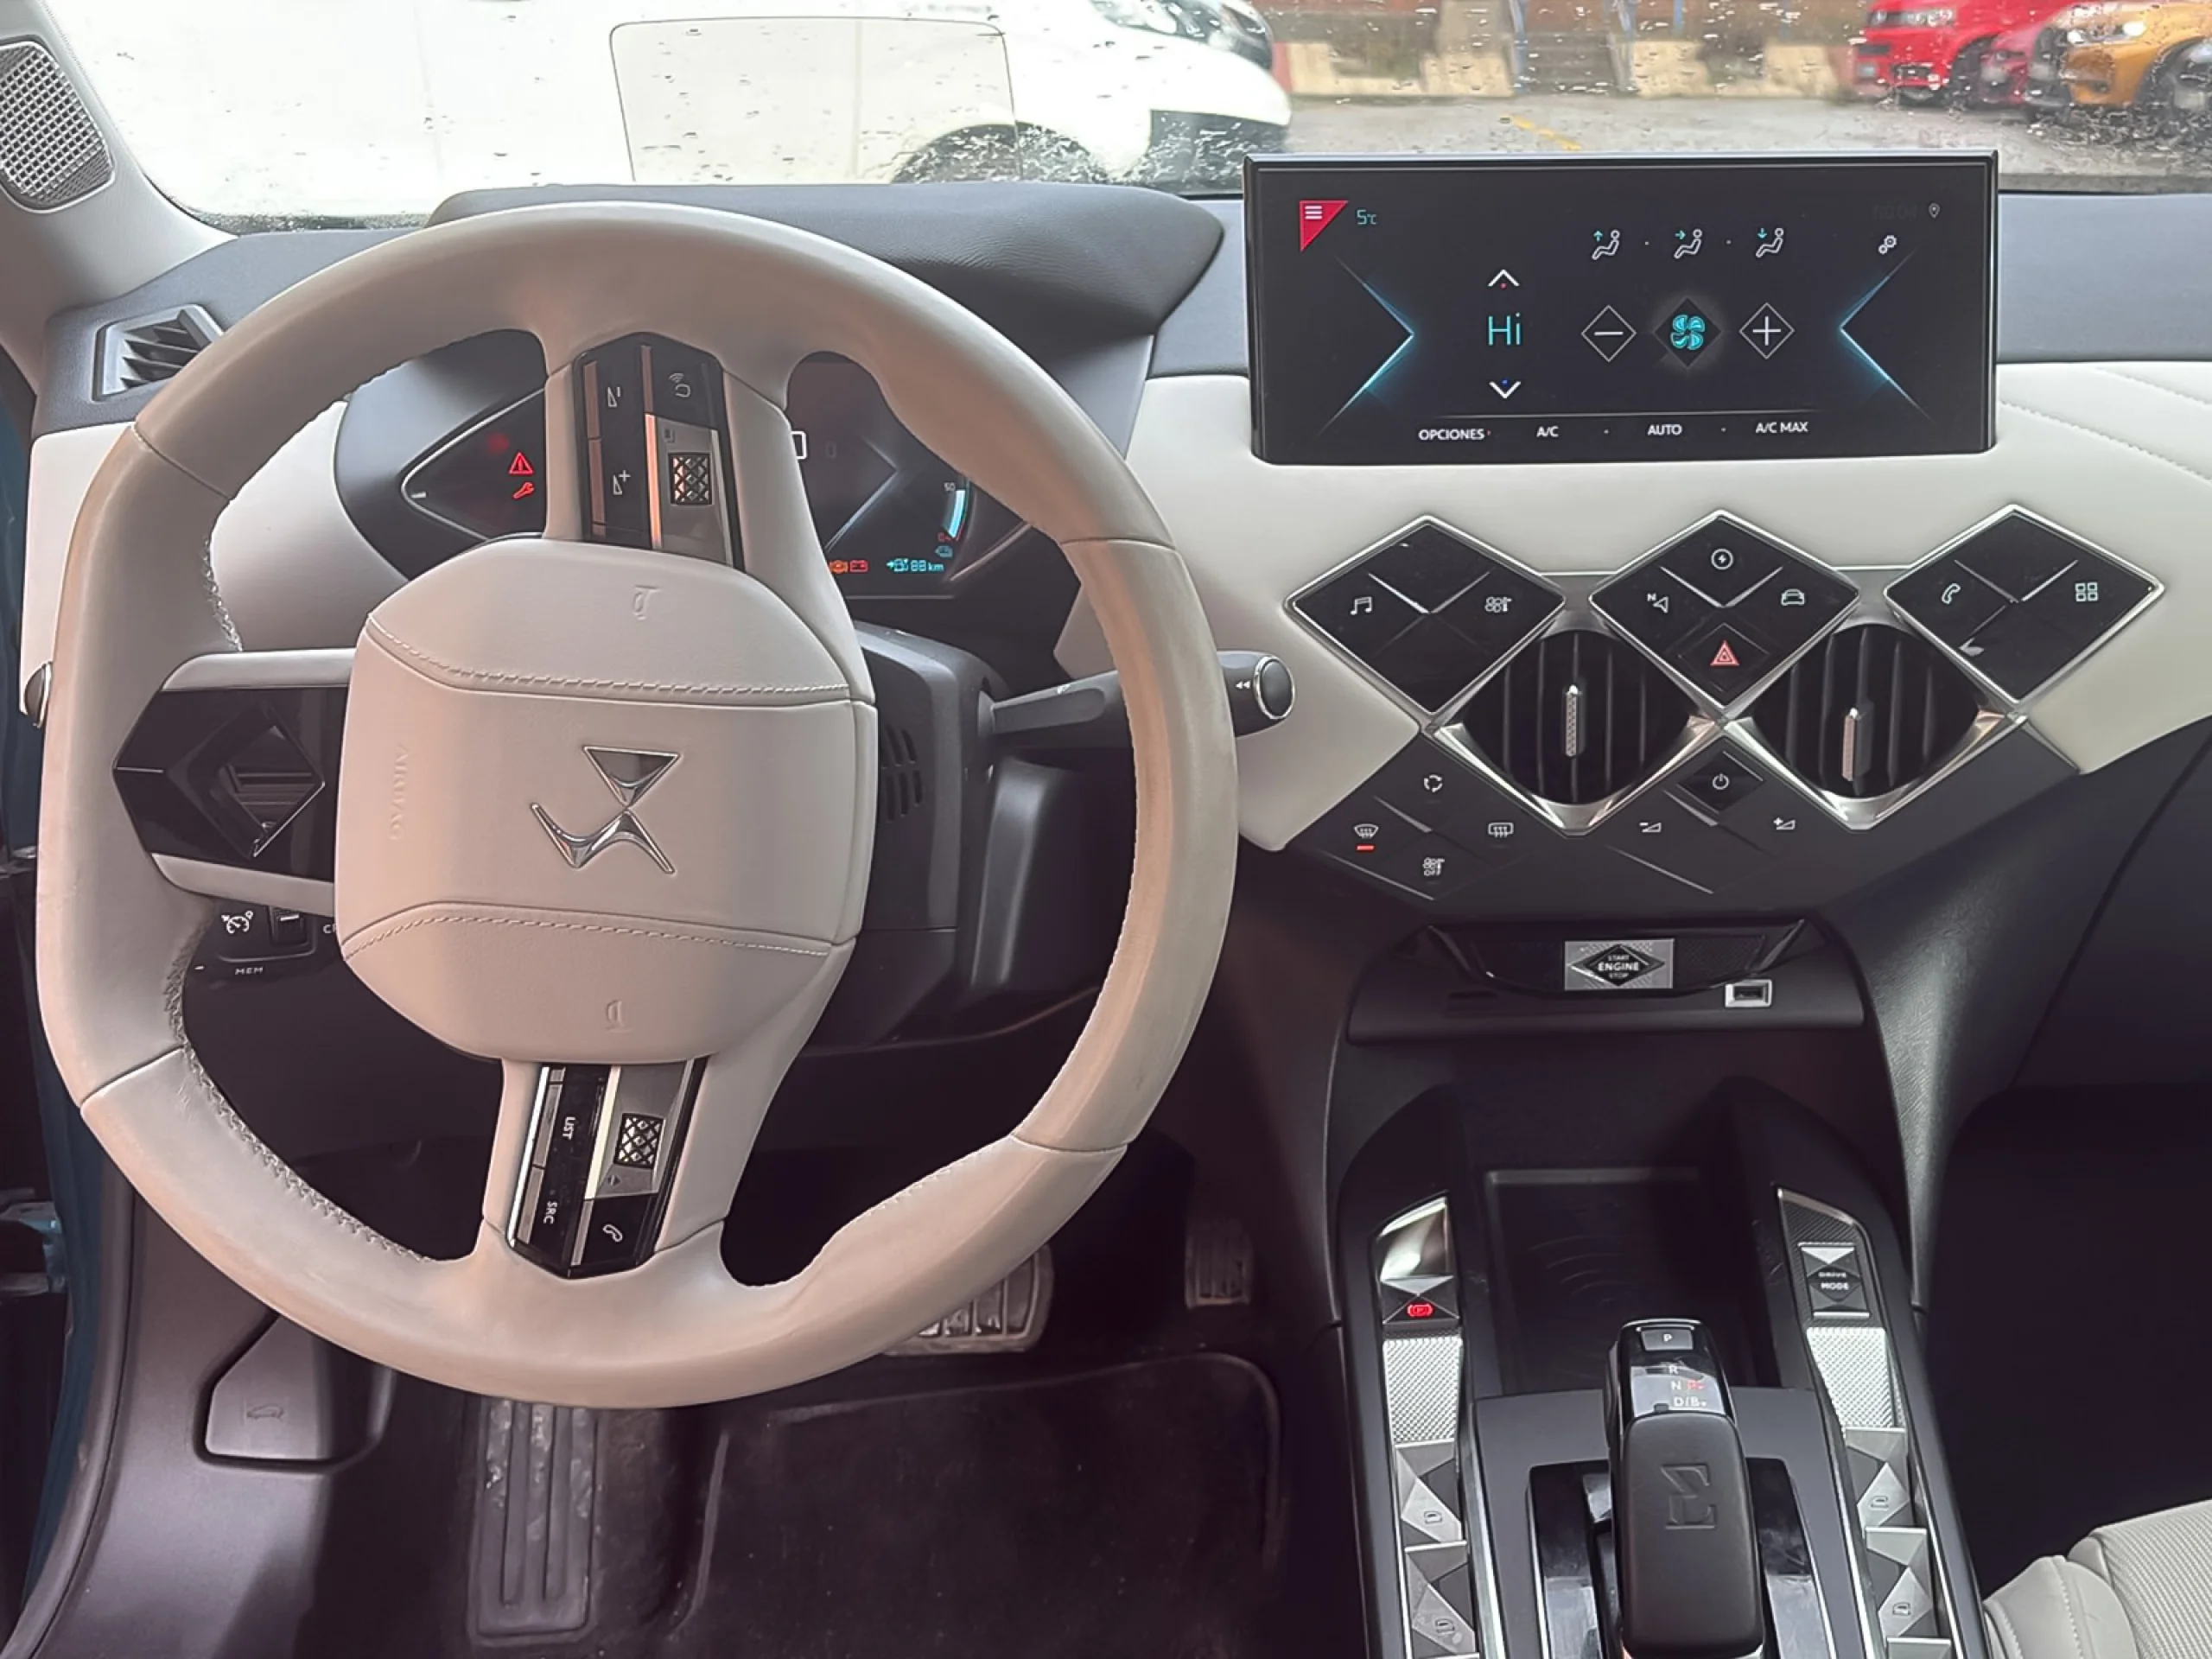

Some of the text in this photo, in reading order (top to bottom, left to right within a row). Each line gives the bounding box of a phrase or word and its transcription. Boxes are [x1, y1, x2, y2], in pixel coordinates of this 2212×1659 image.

[1488, 312, 1521, 346] Hi
[1536, 426, 1559, 437] A/C
[1647, 424, 1682, 436] AUTO
[1755, 422, 1809, 433] A/C MAX
[1418, 429, 1485, 441] OPCIONES
[388, 742, 409, 841] AIRBAG
[1598, 961, 1639, 971] ENGINE
[562, 1116, 576, 1141] LIST
[543, 1200, 558, 1224] SRC
[1662, 1333, 1674, 1342] P
[1668, 1364, 1679, 1376] R
[1670, 1380, 1682, 1390] N
